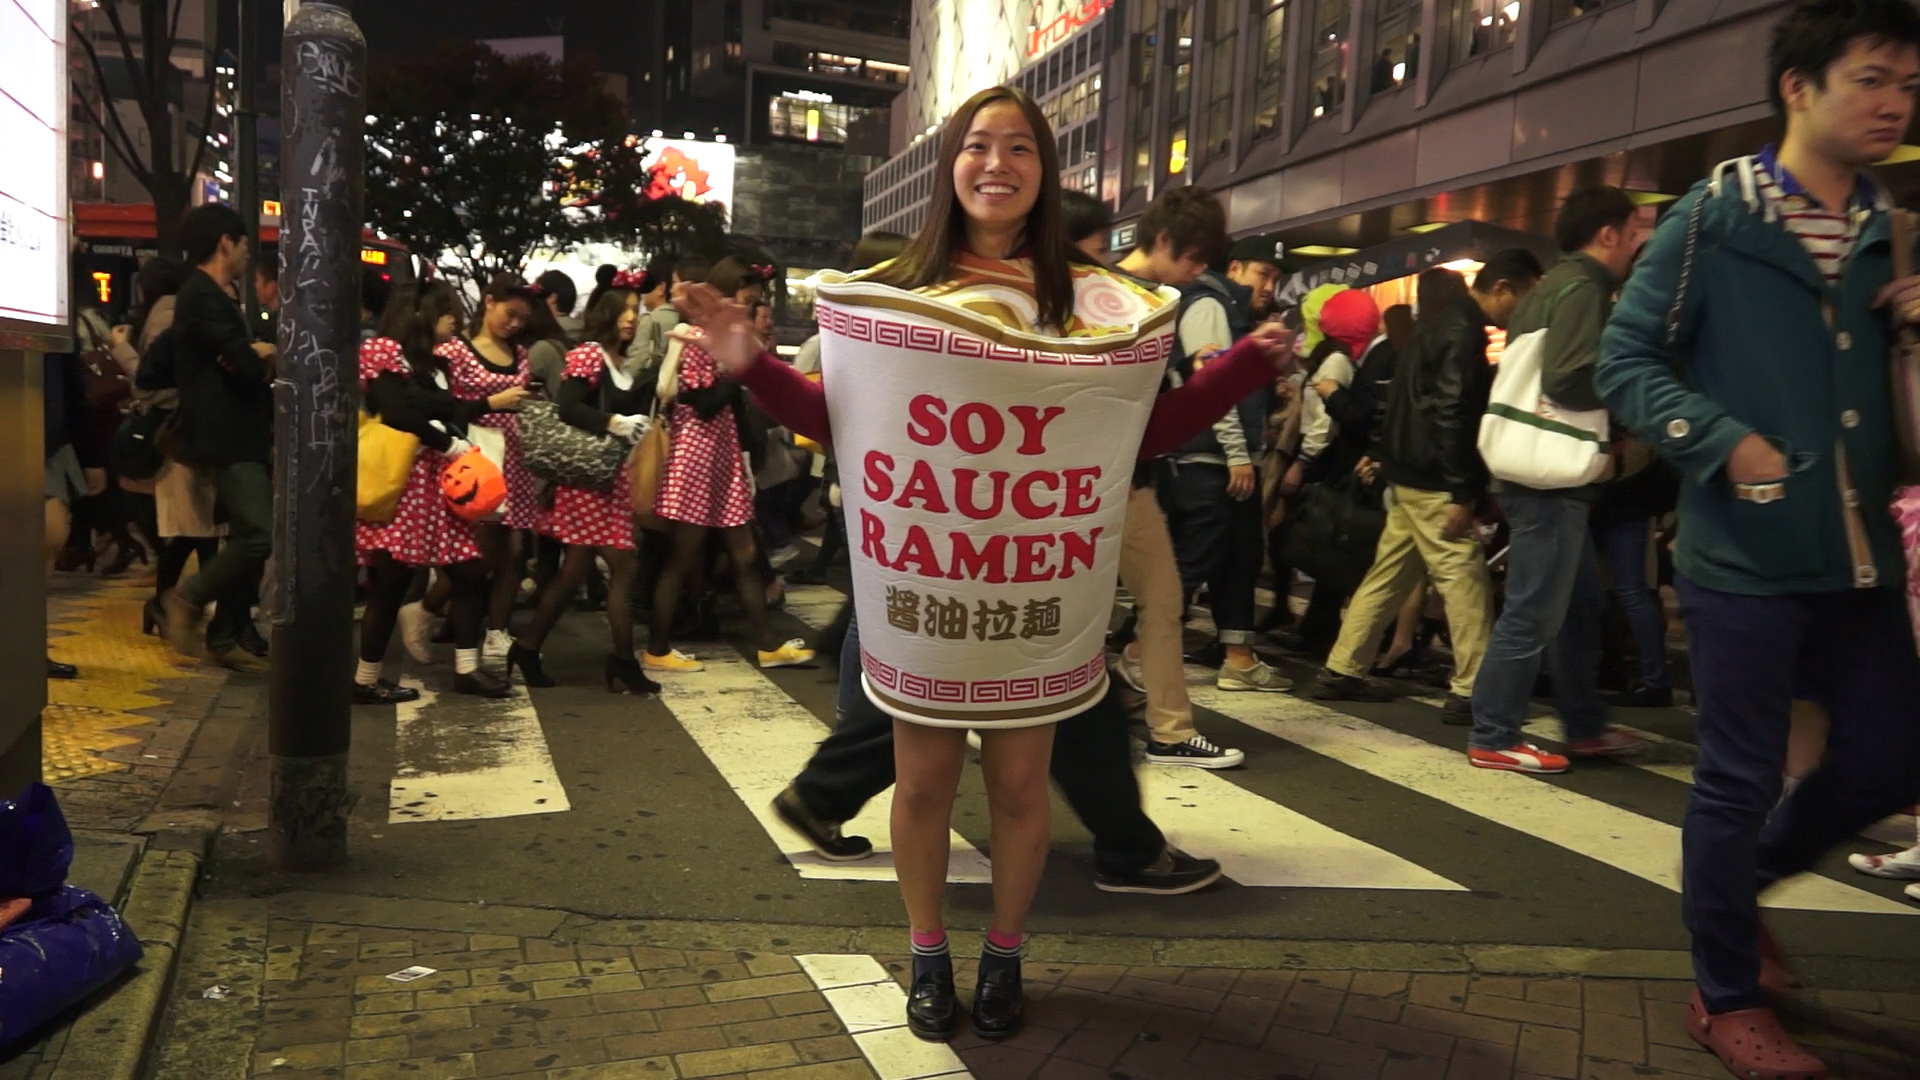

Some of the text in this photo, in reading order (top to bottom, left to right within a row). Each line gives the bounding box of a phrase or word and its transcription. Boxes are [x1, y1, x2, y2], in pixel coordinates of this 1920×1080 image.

[907, 394, 1065, 455] SOY
[863, 450, 1102, 520] SAUCE
[860, 508, 1104, 583] RAMEN
